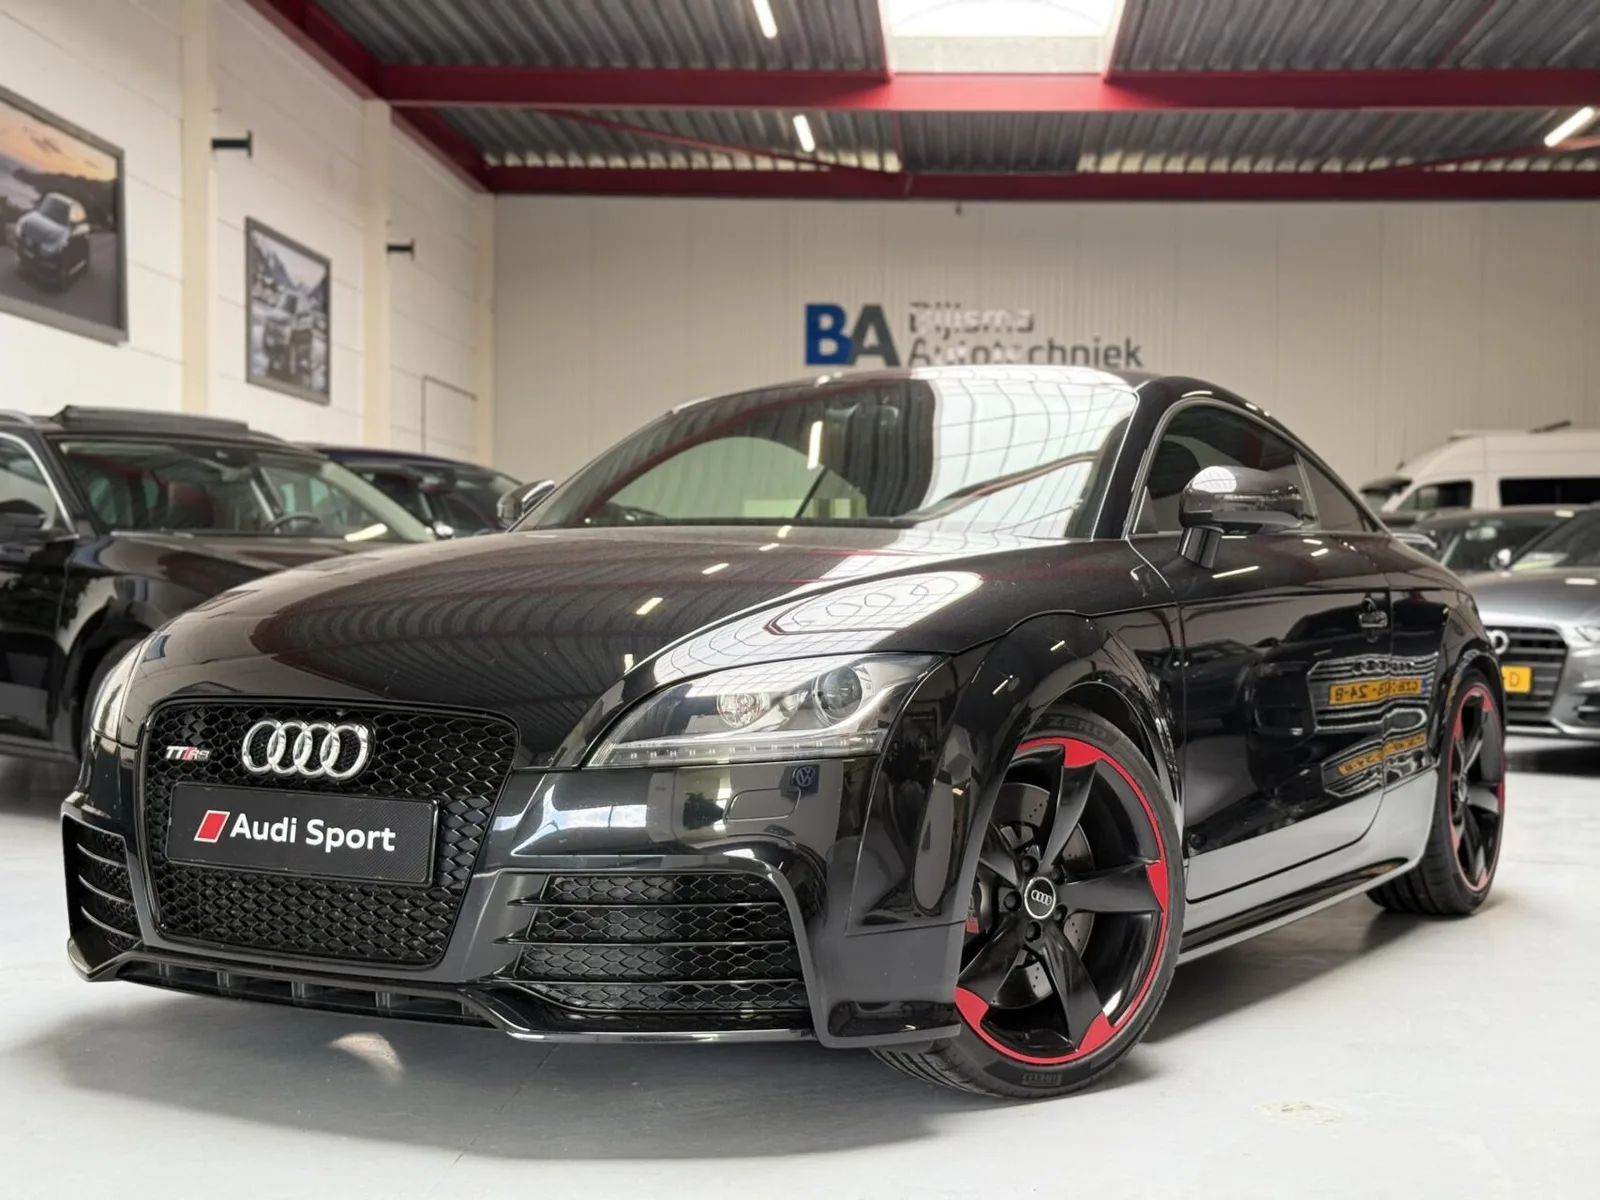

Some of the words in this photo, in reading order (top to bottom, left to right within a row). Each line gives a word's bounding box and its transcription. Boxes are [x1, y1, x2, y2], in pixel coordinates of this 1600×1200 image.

[805, 303, 900, 367] BA
[230, 813, 297, 843] Audi
[305, 819, 396, 852] Sport
